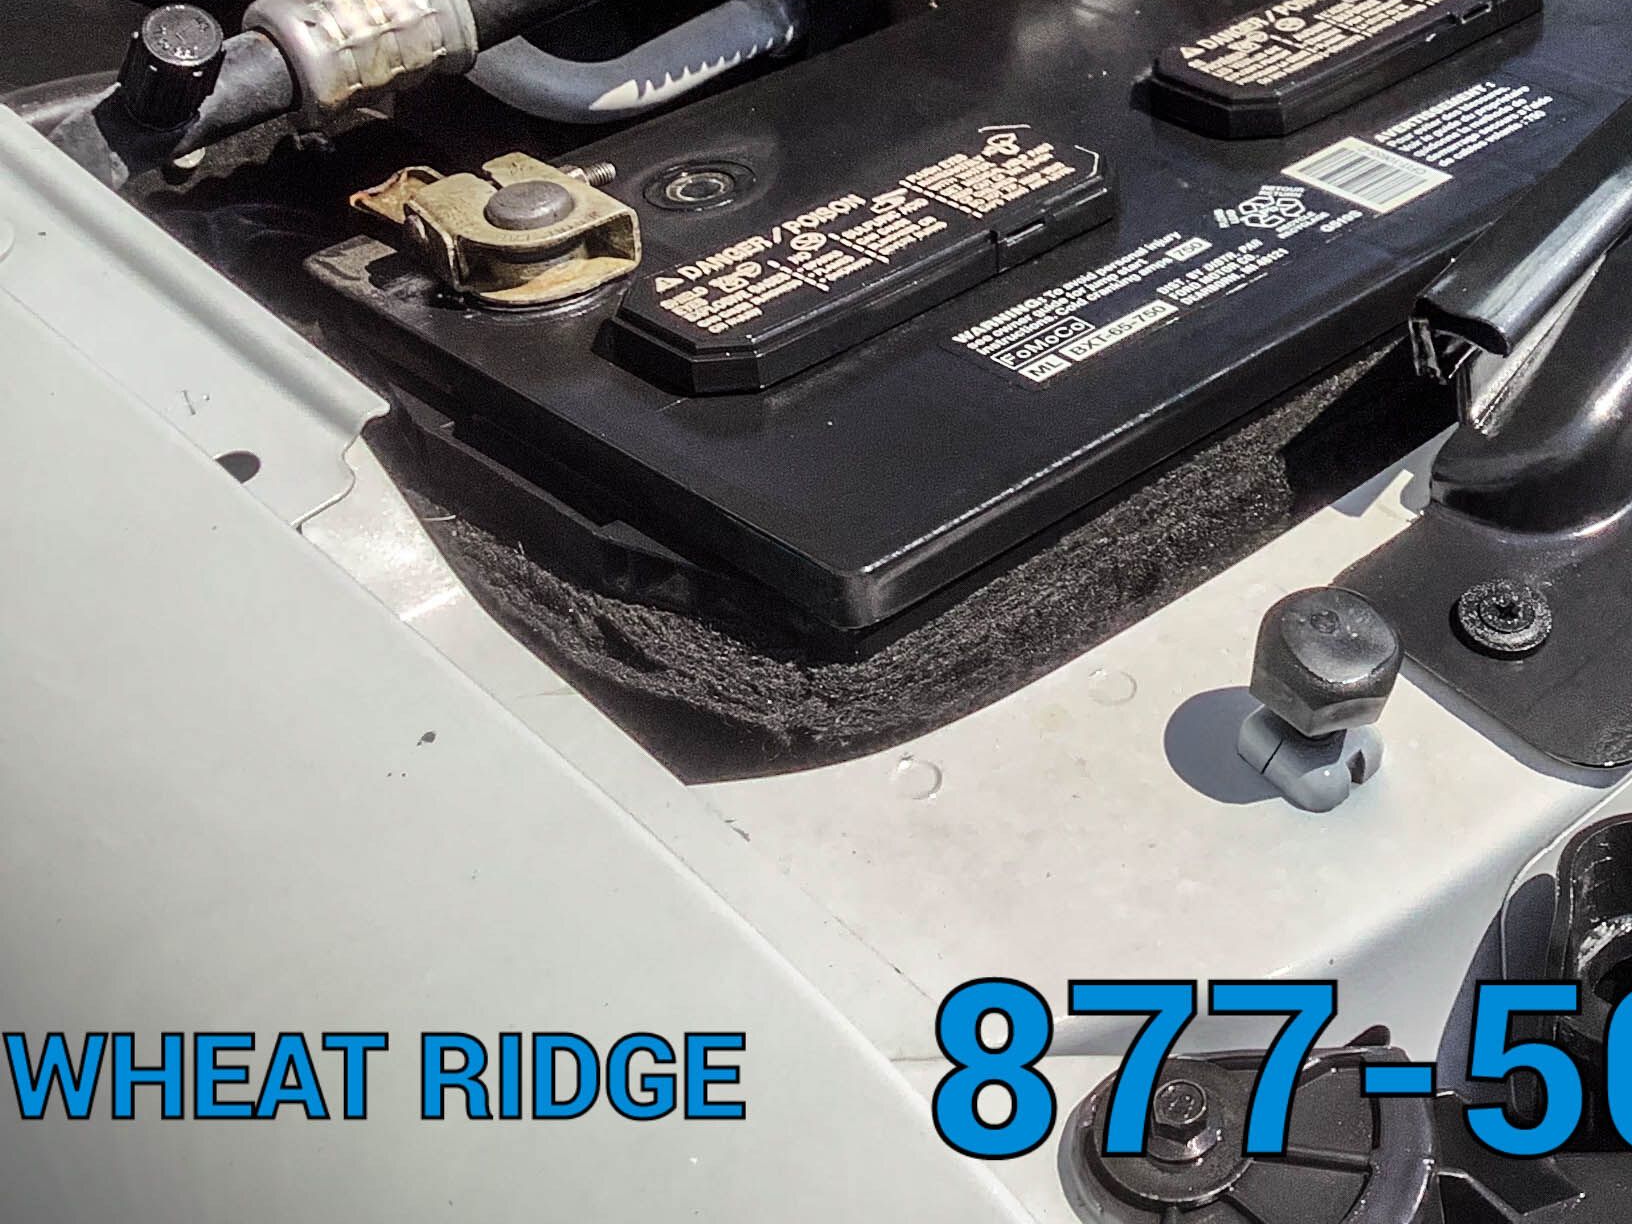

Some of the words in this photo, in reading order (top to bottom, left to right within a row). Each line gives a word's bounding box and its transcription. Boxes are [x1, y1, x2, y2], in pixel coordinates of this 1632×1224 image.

[1197, 16, 1269, 49] DANGER
[1374, 84, 1487, 142] AVERTISSEMENT
[677, 235, 773, 280] DANGER
[782, 193, 866, 235] POISON
[952, 294, 1047, 343] WARNING:
[1046, 287, 1064, 299] To
[1062, 271, 1098, 291] avoid
[1096, 246, 1149, 277] personal
[1143, 231, 1182, 251] injury
[967, 335, 994, 350] see
[993, 316, 1034, 337] owner
[1032, 298, 1070, 318] guide
[1064, 286, 1089, 300] for
[1085, 273, 1118, 291] jump
[1117, 258, 1149, 275] start
[976, 314, 1058, 355] instructions.
[1054, 298, 1089, 316] Cold
[1087, 274, 1141, 301] cranking
[1138, 257, 1173, 276] amps
[1175, 240, 1203, 257] 750
[1168, 279, 1203, 300] FORD
[1200, 260, 1240, 284] MOTOR
[1179, 272, 1246, 306] DEARBORN,
[1001, 322, 1086, 366] FoMoCo
[1030, 359, 1066, 378] ML
[1070, 305, 1166, 356] BXT-65-750
